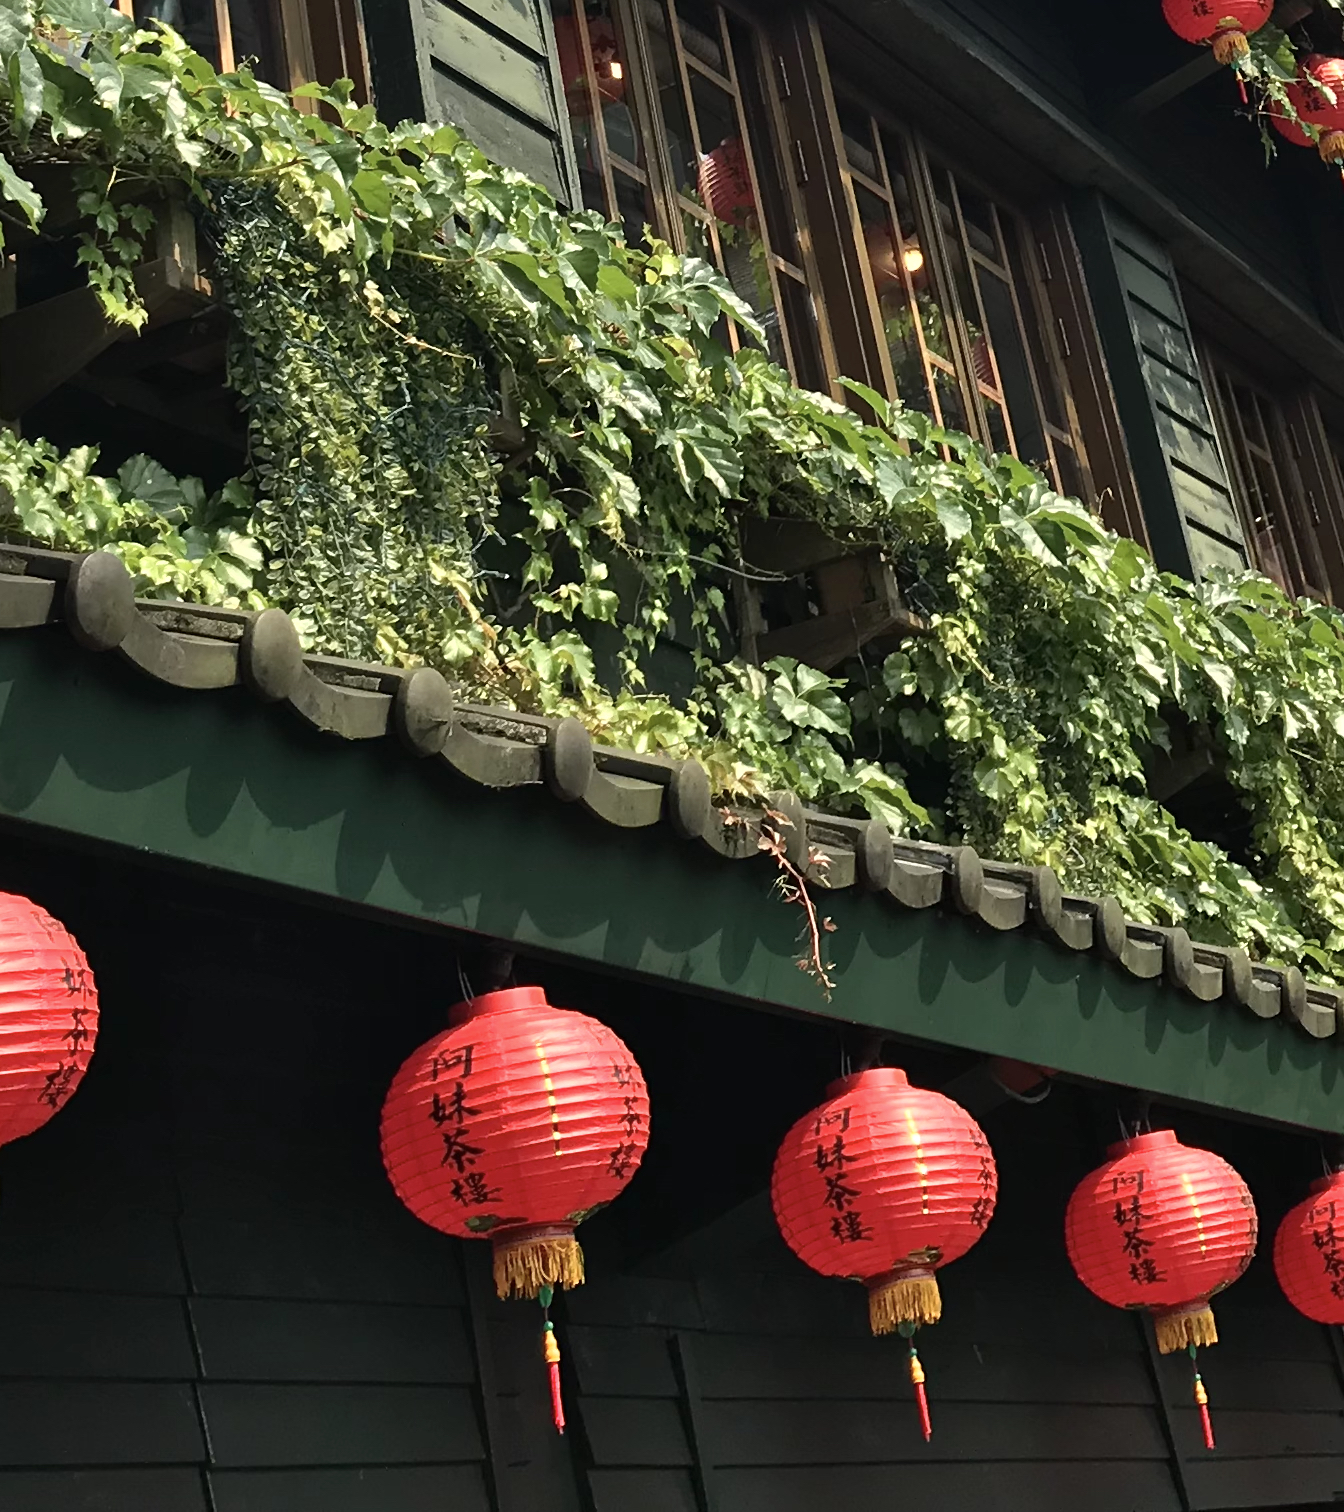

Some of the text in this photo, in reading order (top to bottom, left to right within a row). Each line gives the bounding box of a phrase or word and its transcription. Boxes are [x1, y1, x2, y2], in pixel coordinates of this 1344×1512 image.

[428, 1044, 504, 1208] 阿妹茶樓
[813, 1106, 875, 1245] 阿妹茶樓
[1112, 1170, 1168, 1286] 阿妹茶樓
